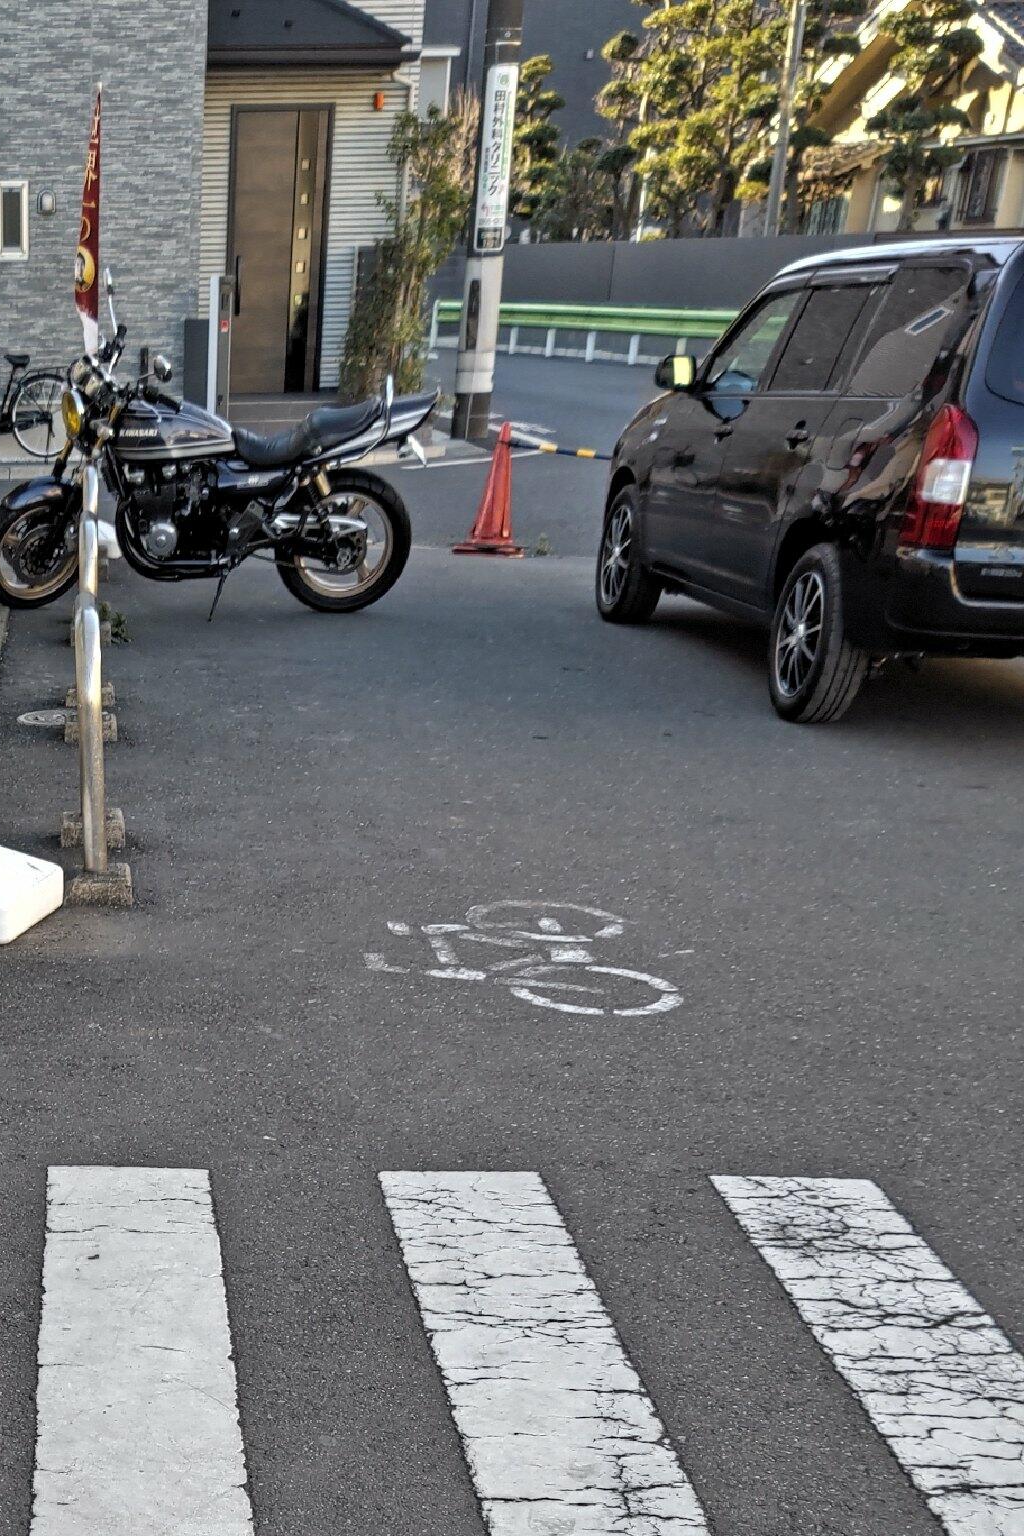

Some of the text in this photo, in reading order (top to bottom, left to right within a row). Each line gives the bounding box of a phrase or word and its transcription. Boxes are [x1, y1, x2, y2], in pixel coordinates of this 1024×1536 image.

[488, 90, 506, 196] 田村外科クリニック
[119, 428, 159, 438] KAWASAKI
